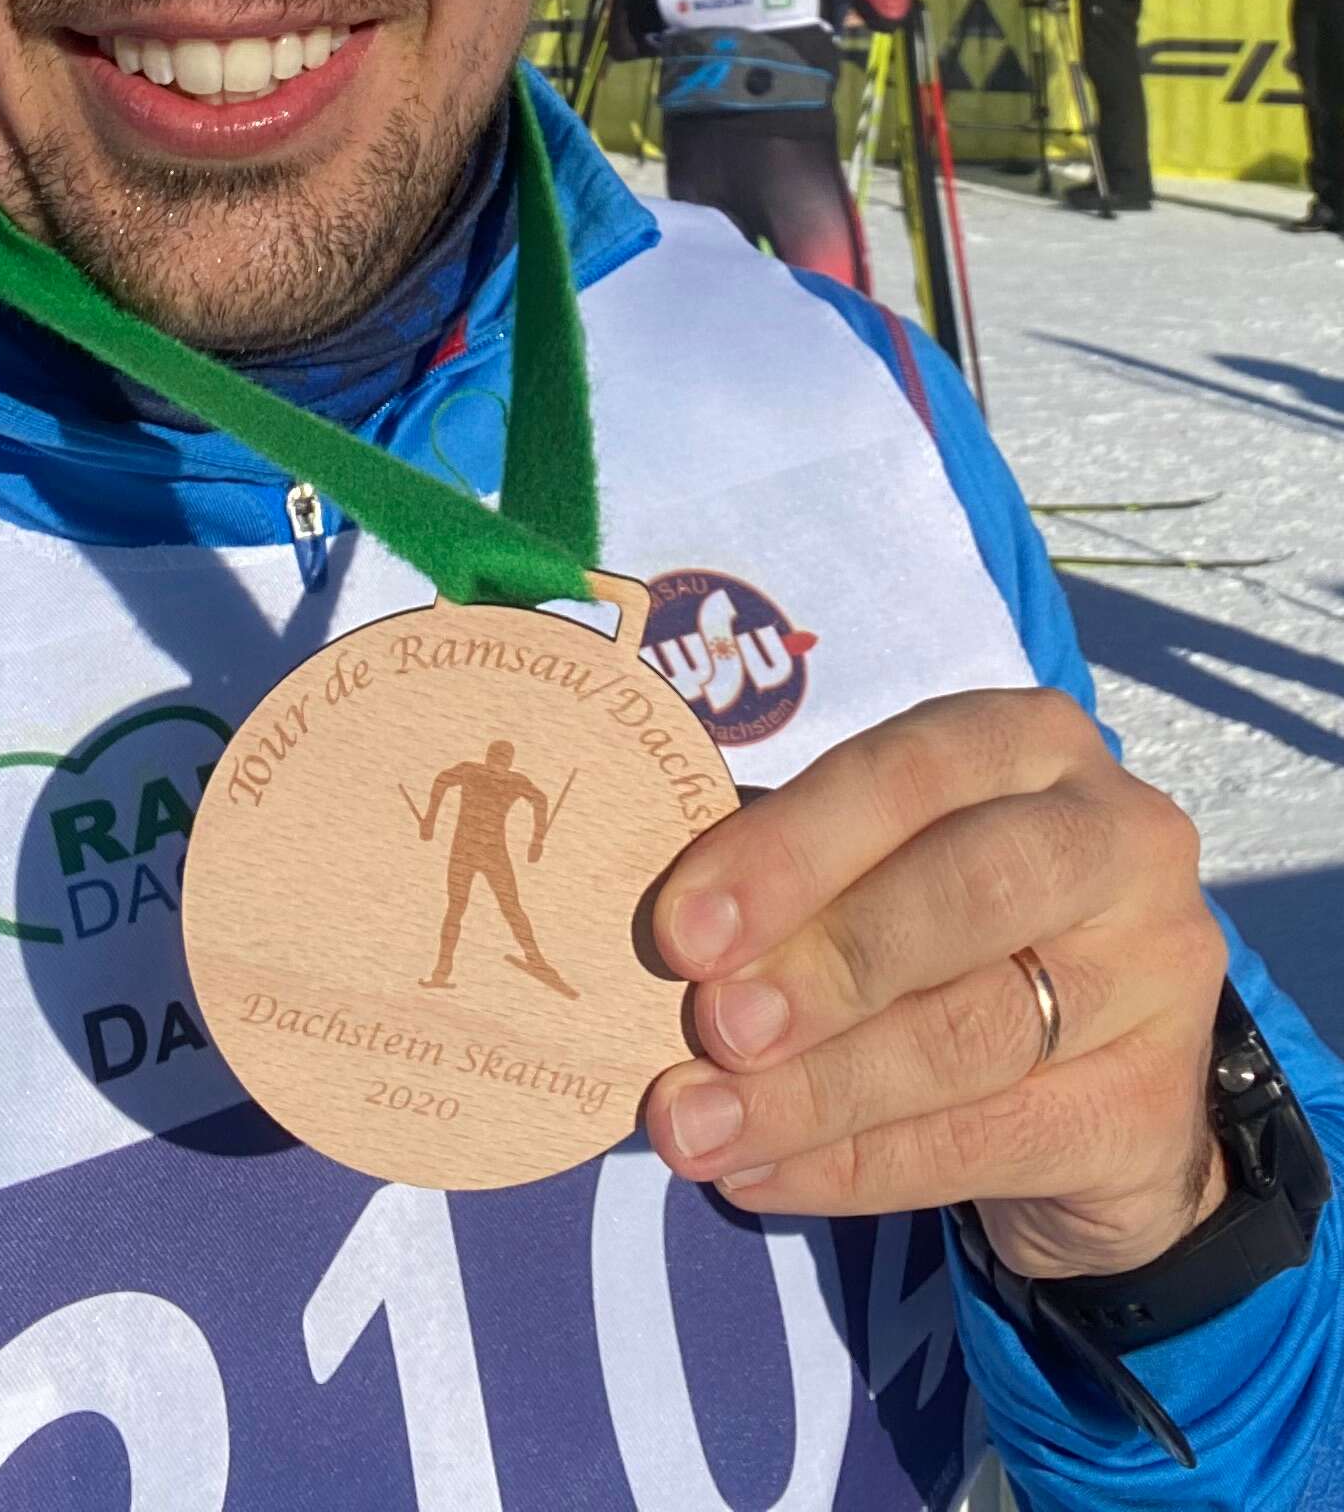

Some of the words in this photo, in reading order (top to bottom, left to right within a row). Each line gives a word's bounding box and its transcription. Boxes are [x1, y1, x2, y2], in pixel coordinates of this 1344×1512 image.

[228, 693, 310, 807] Tour
[324, 649, 374, 705] de
[390, 634, 717, 838] Ramsau/Dachs
[49, 763, 217, 876] RA
[67, 854, 187, 938] DA
[240, 992, 445, 1067] Dachstein
[455, 1042, 614, 1116] Skating
[364, 1080, 461, 1122] 2020
